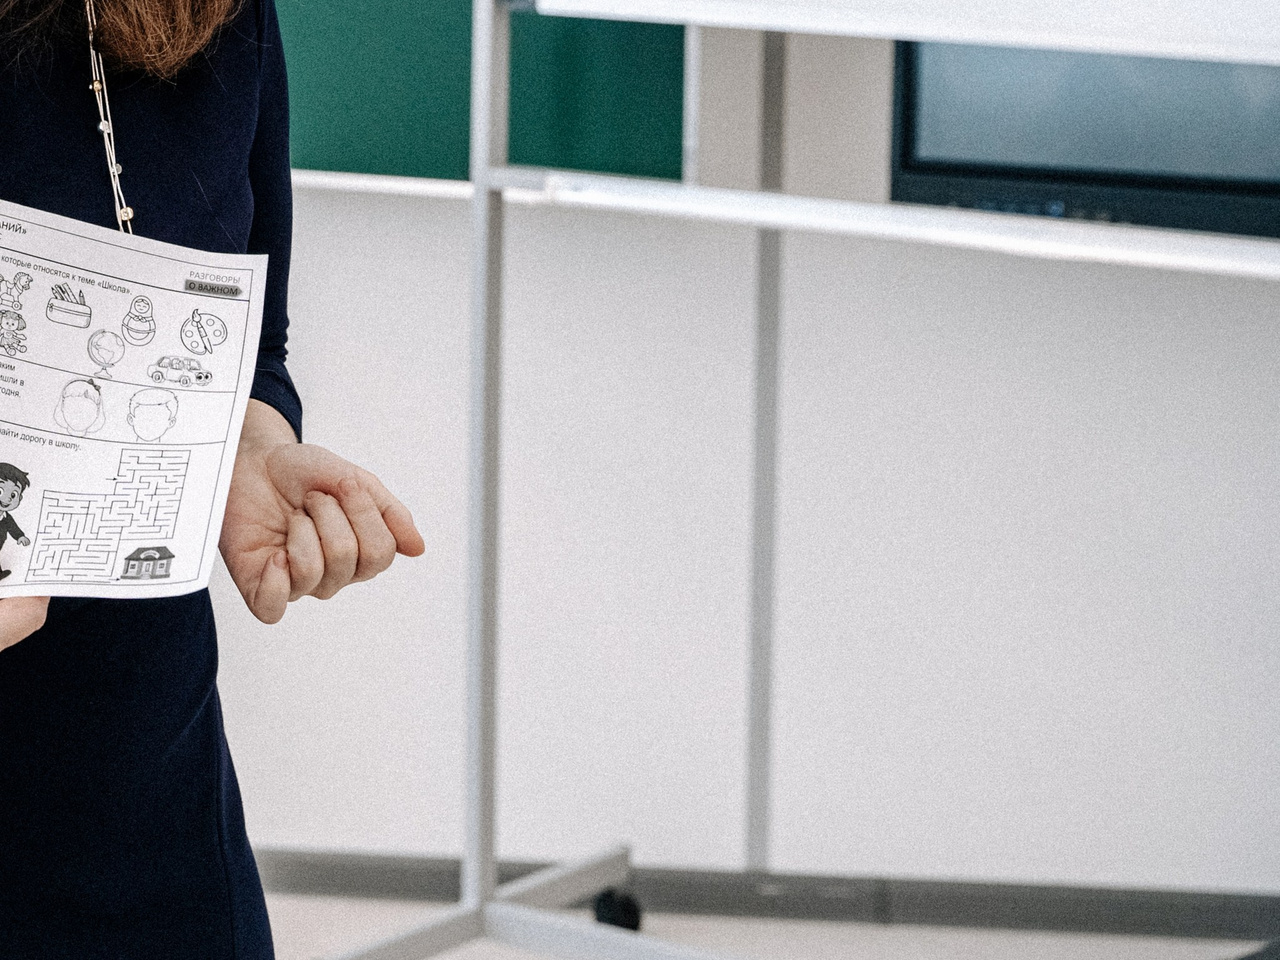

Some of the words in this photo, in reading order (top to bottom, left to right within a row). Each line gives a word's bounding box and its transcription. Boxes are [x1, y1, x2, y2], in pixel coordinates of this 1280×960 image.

[0, 254, 31, 269] которые
[32, 263, 70, 279] относятся
[77, 275, 96, 286] теме
[96, 279, 132, 295] «Школа».
[188, 270, 240, 283] РАЗГОВОРЫ
[187, 281, 196, 290] О
[197, 283, 238, 295] ВАЖНОМ
[19, 432, 46, 445] дорогу
[54, 439, 82, 451] школу.
